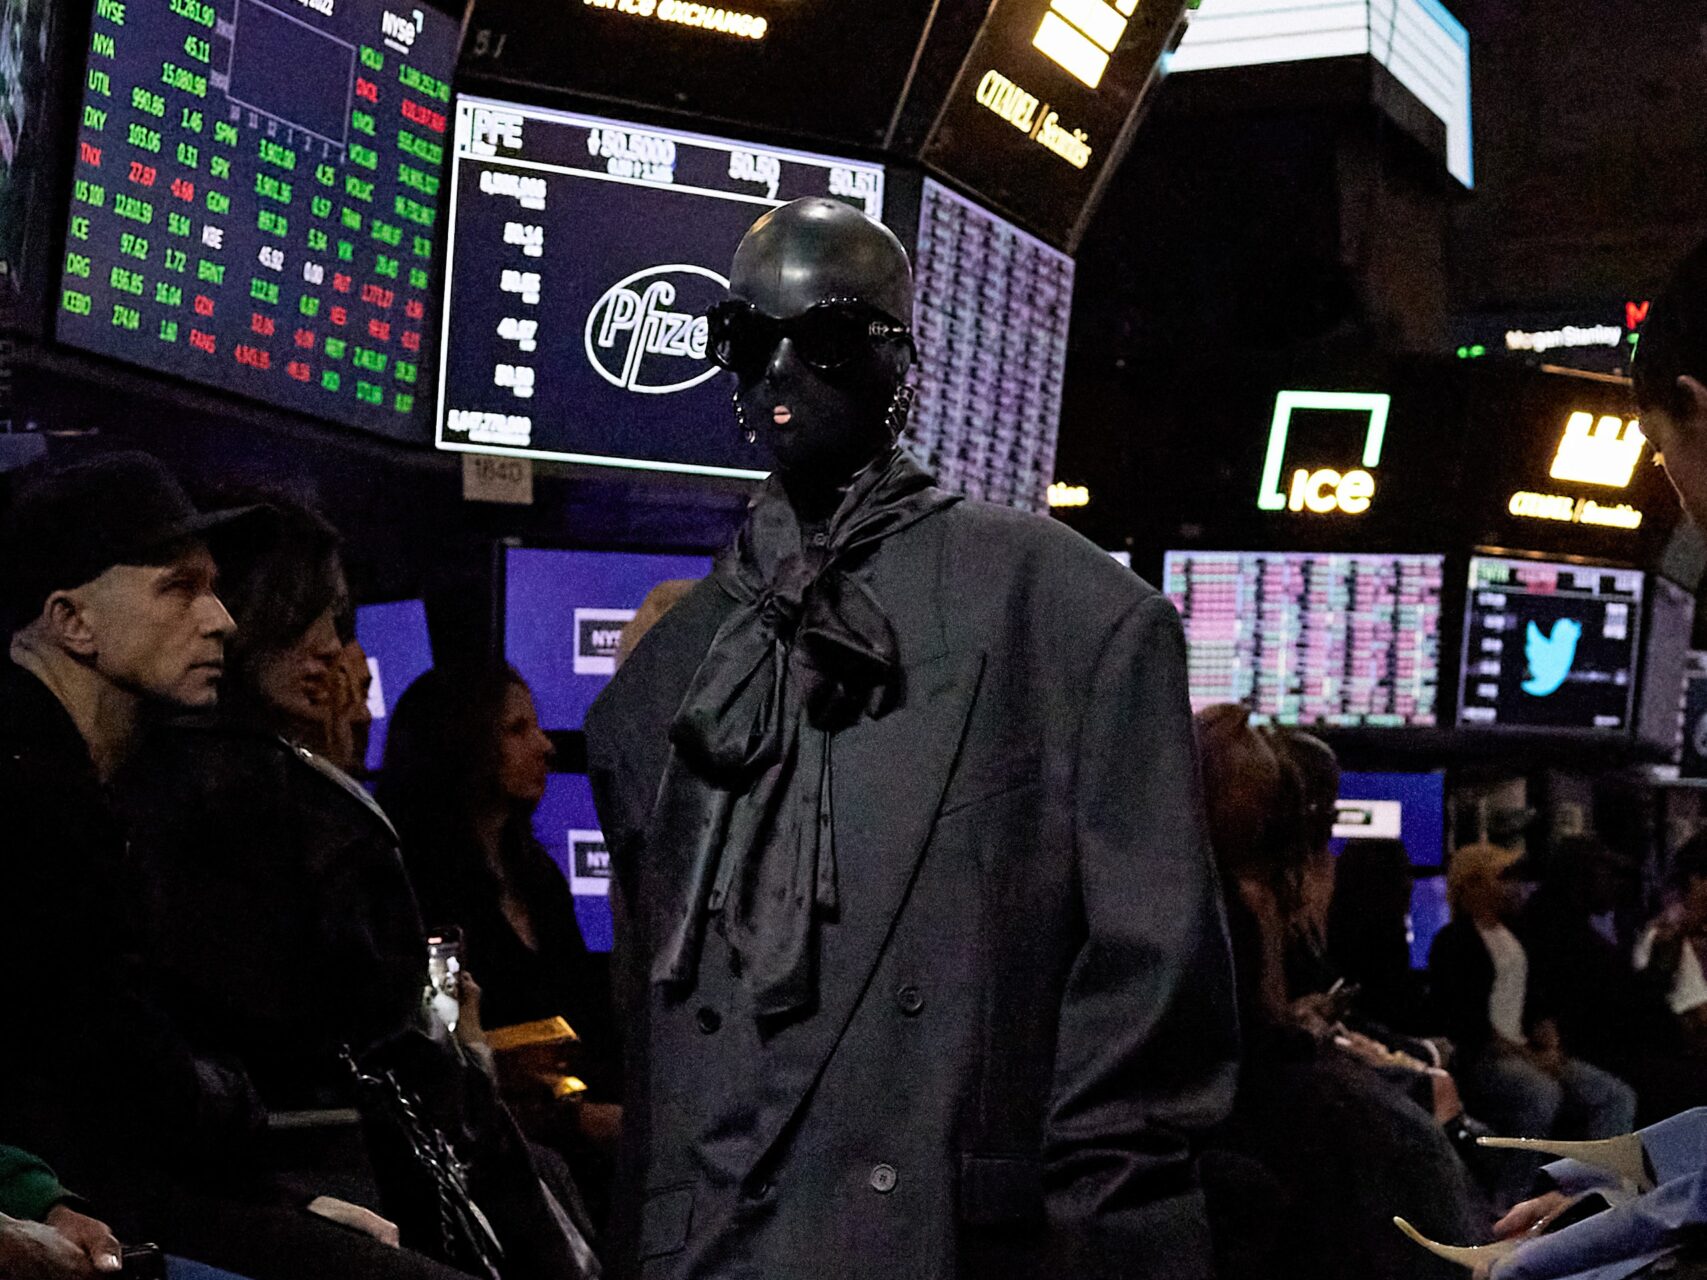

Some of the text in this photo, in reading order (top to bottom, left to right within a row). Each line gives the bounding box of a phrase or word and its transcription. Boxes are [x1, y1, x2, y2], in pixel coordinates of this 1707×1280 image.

[92, 32, 115, 60] NYA
[88, 69, 111, 97] UTIL
[598, 281, 709, 388] Pfize
